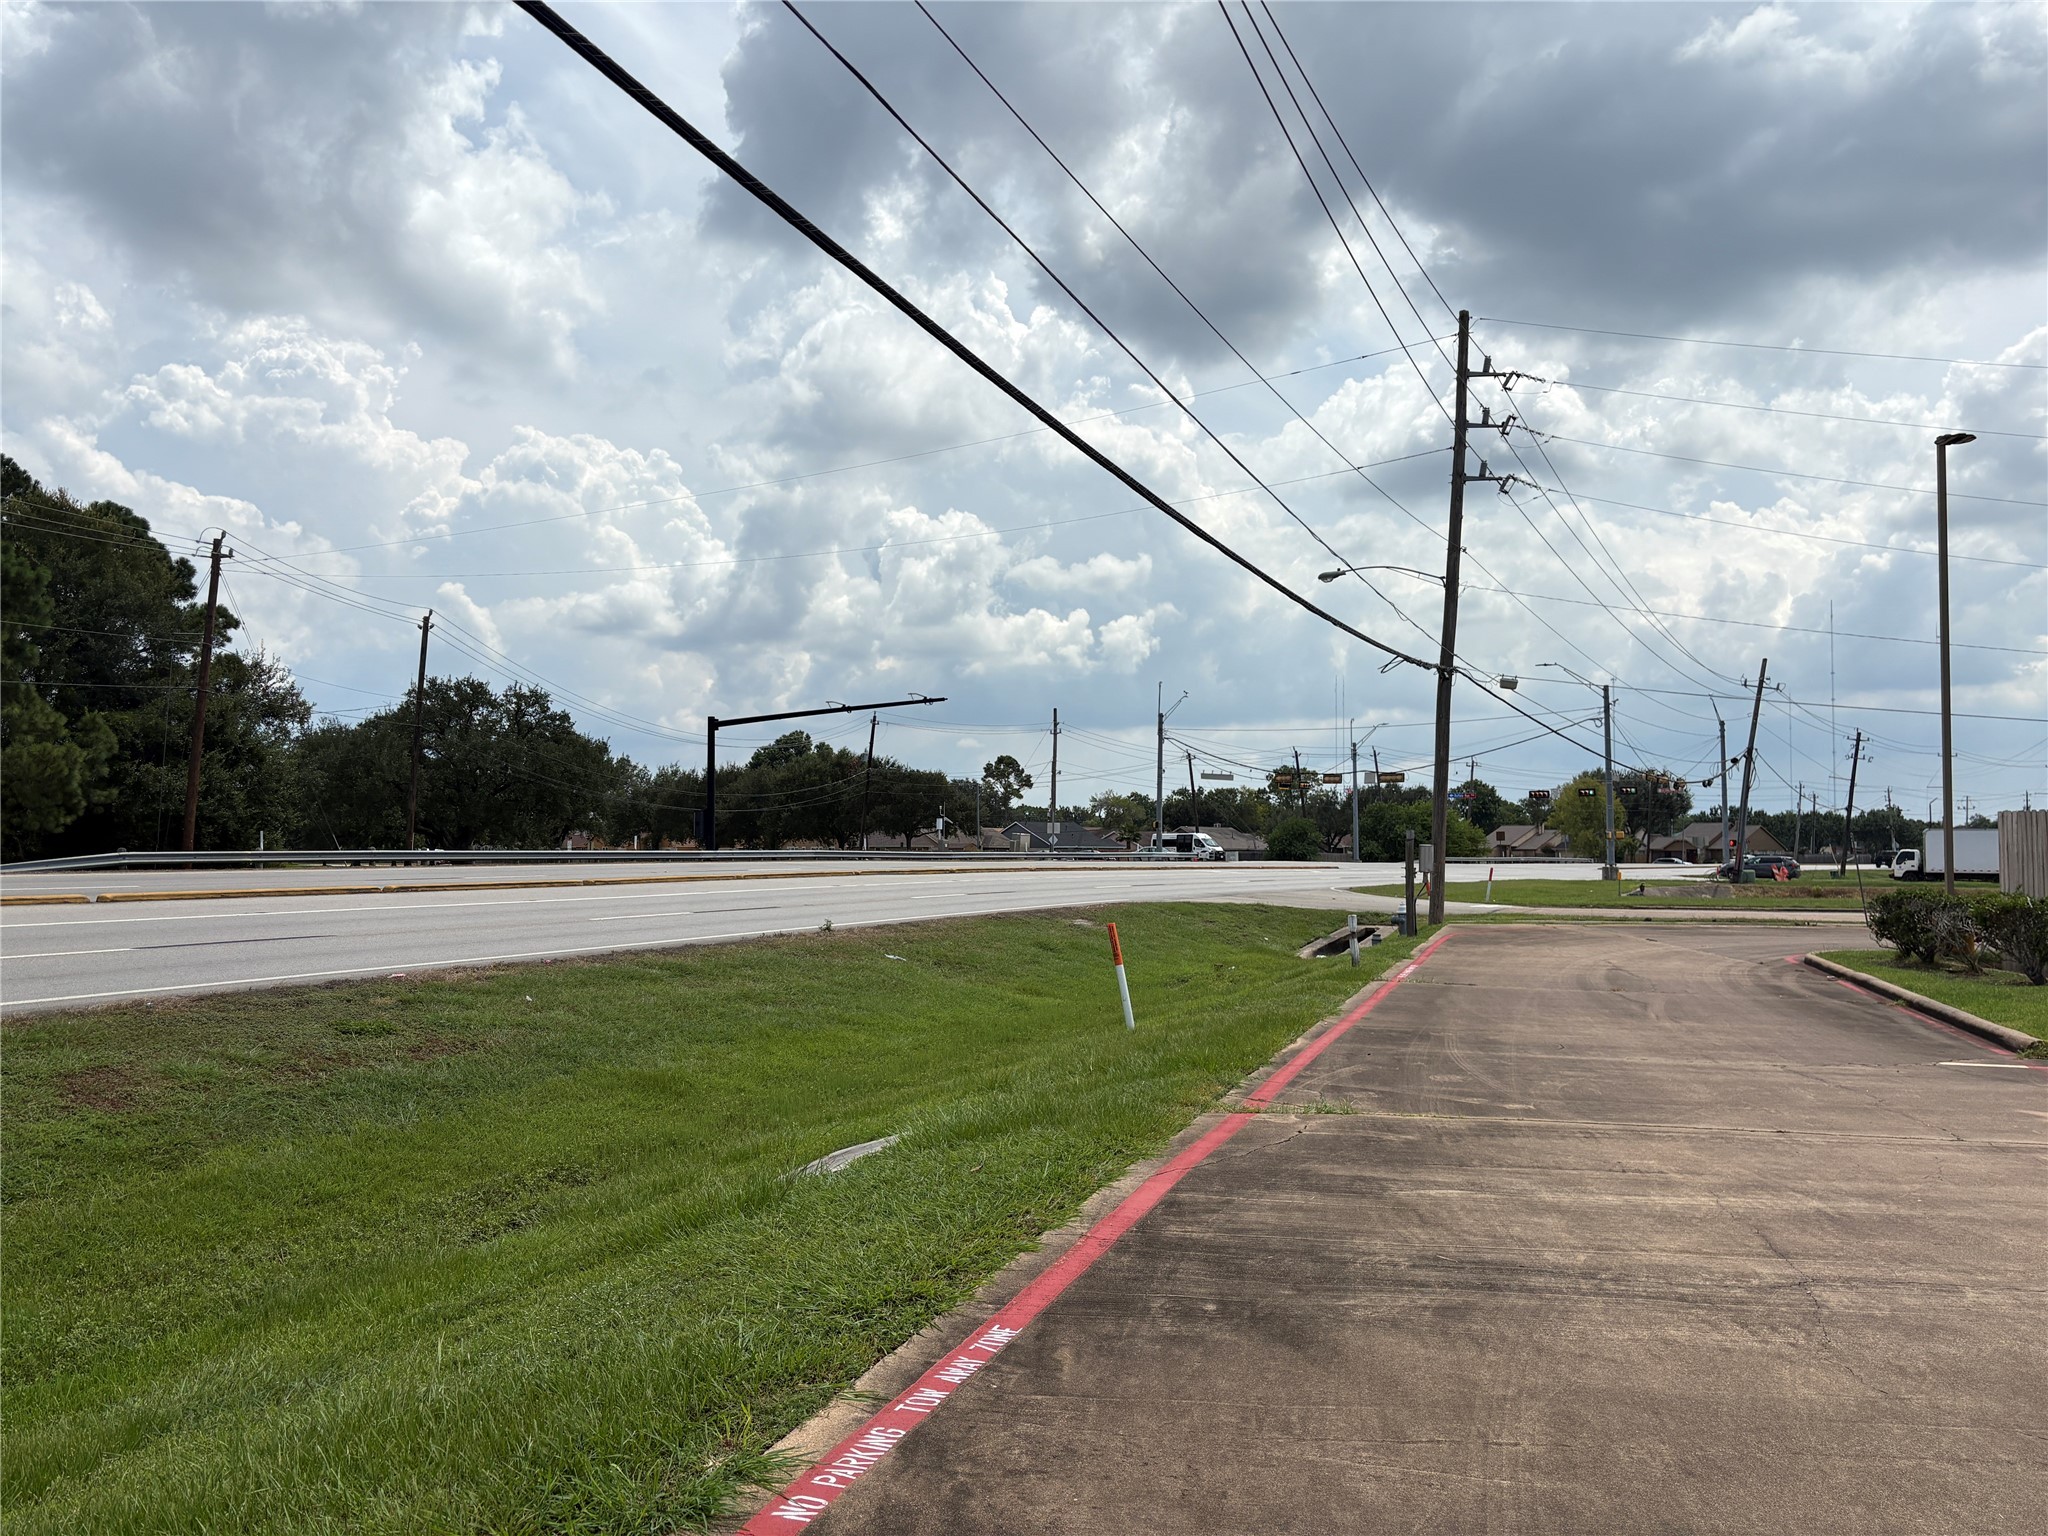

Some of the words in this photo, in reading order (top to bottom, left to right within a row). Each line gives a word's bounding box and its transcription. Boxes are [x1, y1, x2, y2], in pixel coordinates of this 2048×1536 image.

[771, 1495, 829, 1522] NO
[811, 1426, 906, 1488] PARKING
[894, 1388, 949, 1413] TOW
[934, 1356, 985, 1384] AWAY
[969, 1324, 1023, 1352] ZONE
